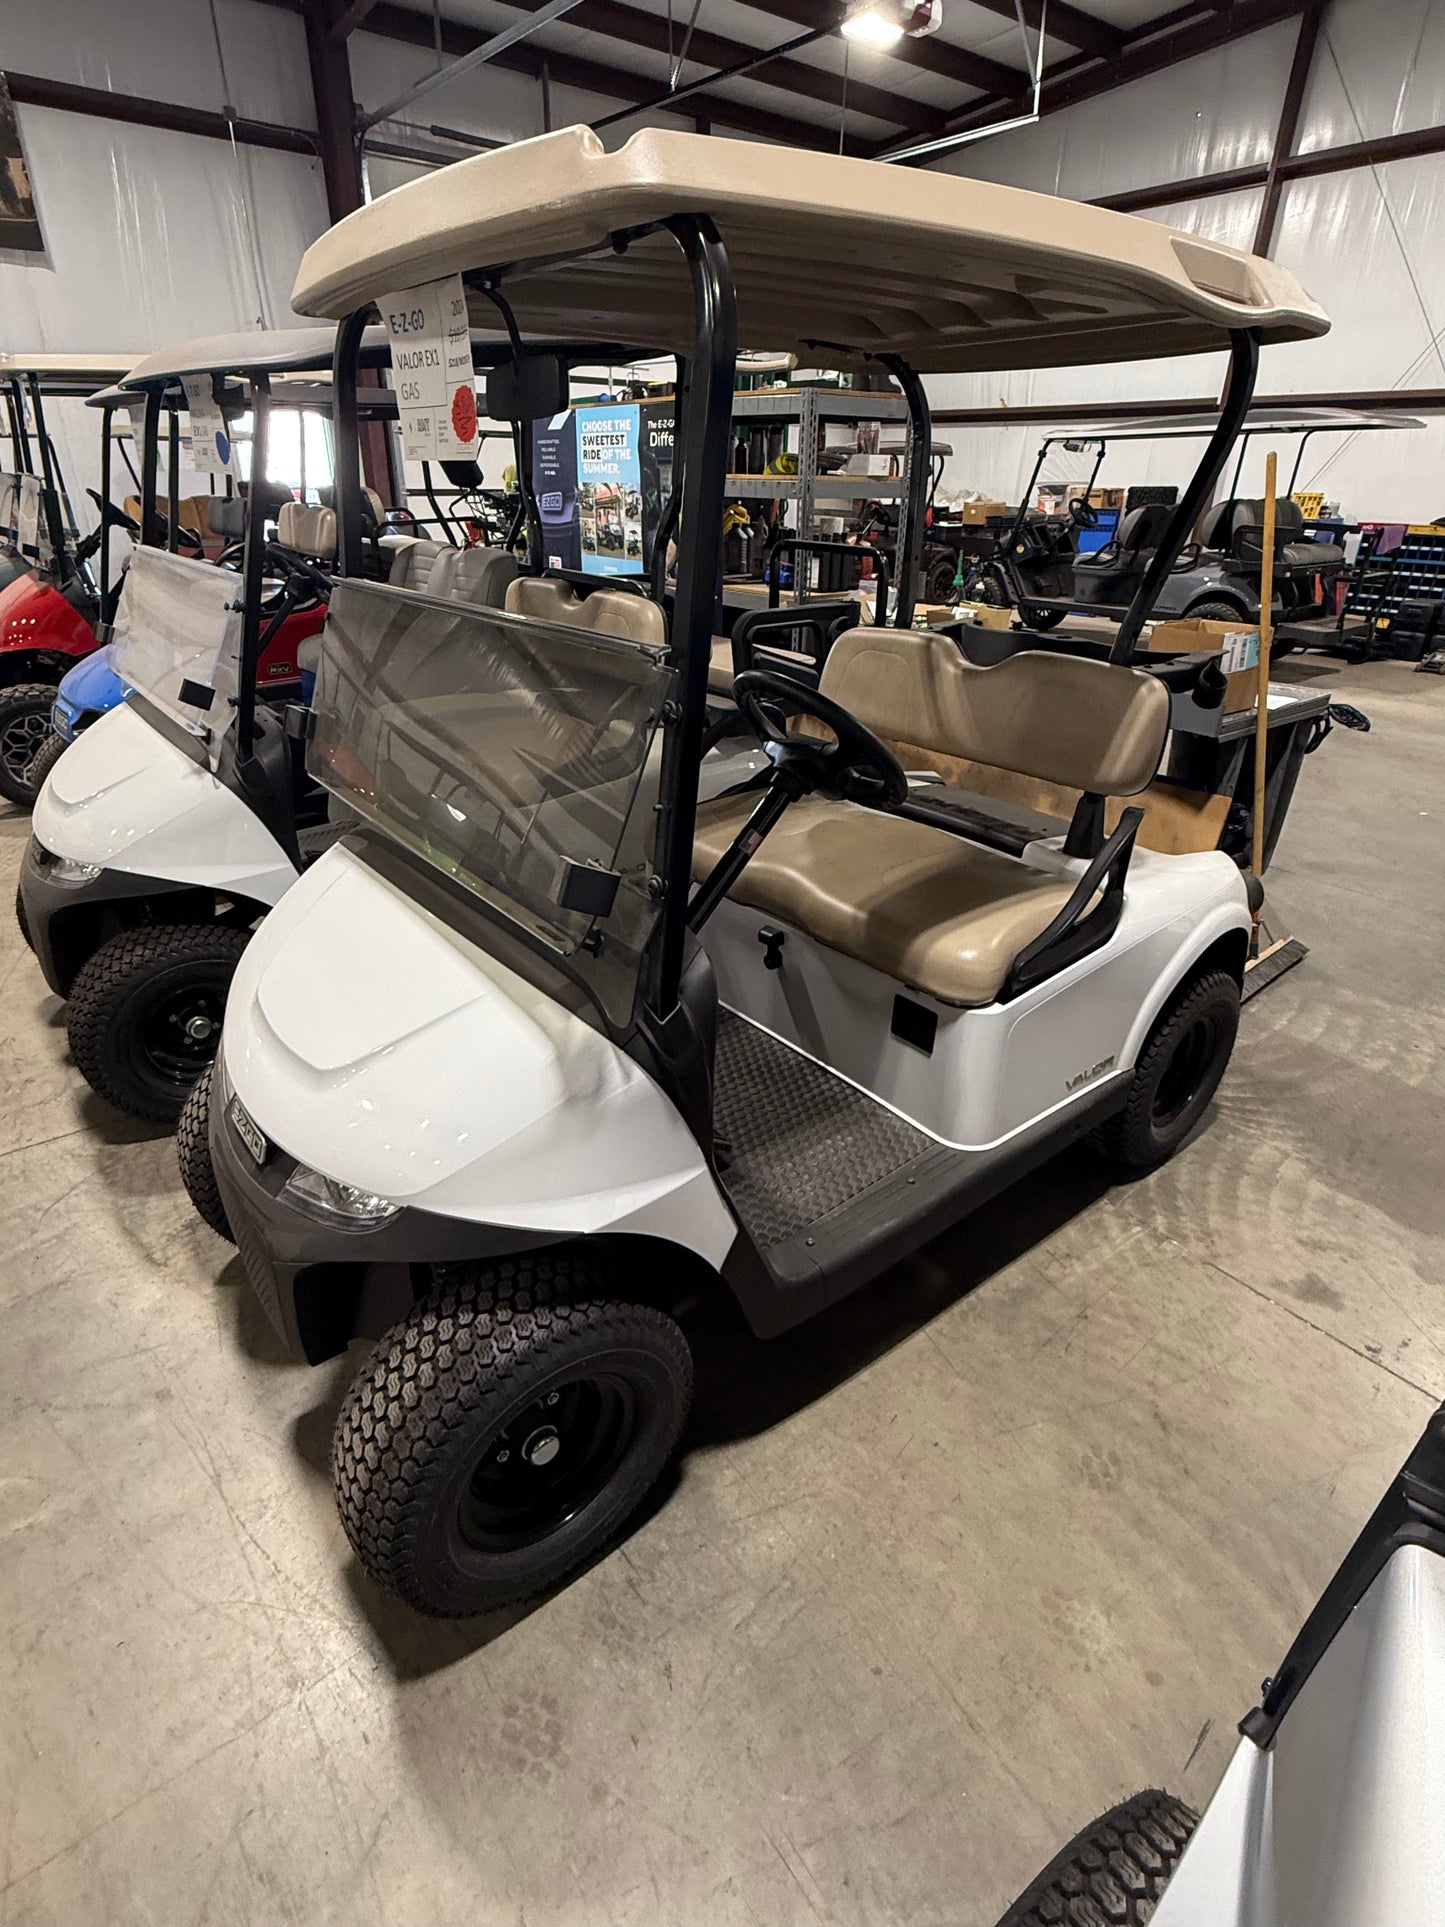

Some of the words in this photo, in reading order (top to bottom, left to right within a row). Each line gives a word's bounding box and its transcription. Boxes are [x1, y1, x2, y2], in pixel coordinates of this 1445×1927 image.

[389, 308, 425, 334] E-Z-GO
[396, 350, 424, 370] VALOR
[424, 348, 440, 367] EX1
[401, 382, 420, 400] GAS
[582, 420, 612, 433] CHOOSE
[613, 418, 632, 431] THE
[647, 420, 657, 430] The
[582, 434, 625, 446] SWEETEST
[583, 449, 602, 460] RIDE
[602, 448, 614, 460] OF
[614, 448, 632, 460] THE
[583, 463, 621, 474] SUMMER.
[1065, 1055, 1115, 1091] VALOR
